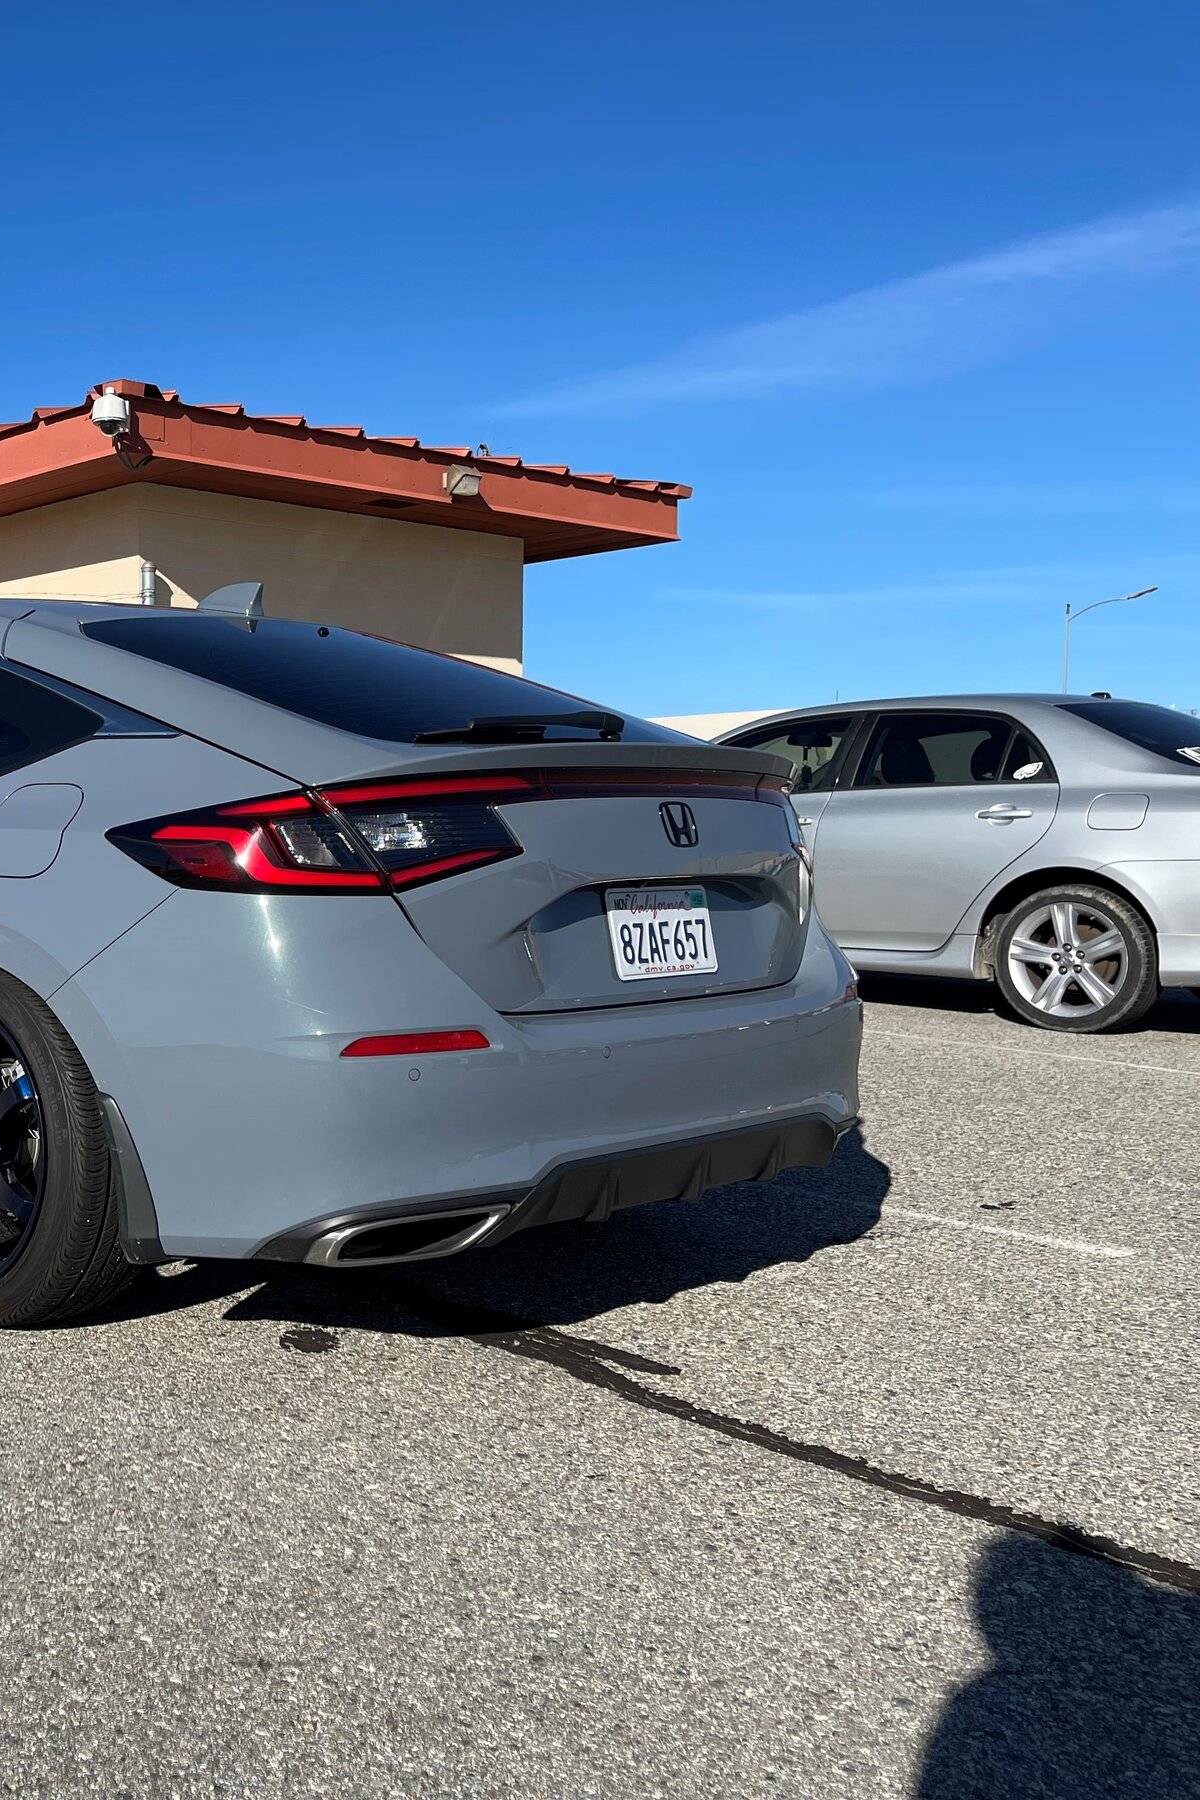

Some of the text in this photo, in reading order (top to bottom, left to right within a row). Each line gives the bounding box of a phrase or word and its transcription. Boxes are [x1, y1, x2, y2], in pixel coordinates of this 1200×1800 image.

[630, 893, 689, 919] California
[620, 918, 708, 965] 8ZAF657
[644, 963, 696, 974] dmv.ca.gov
